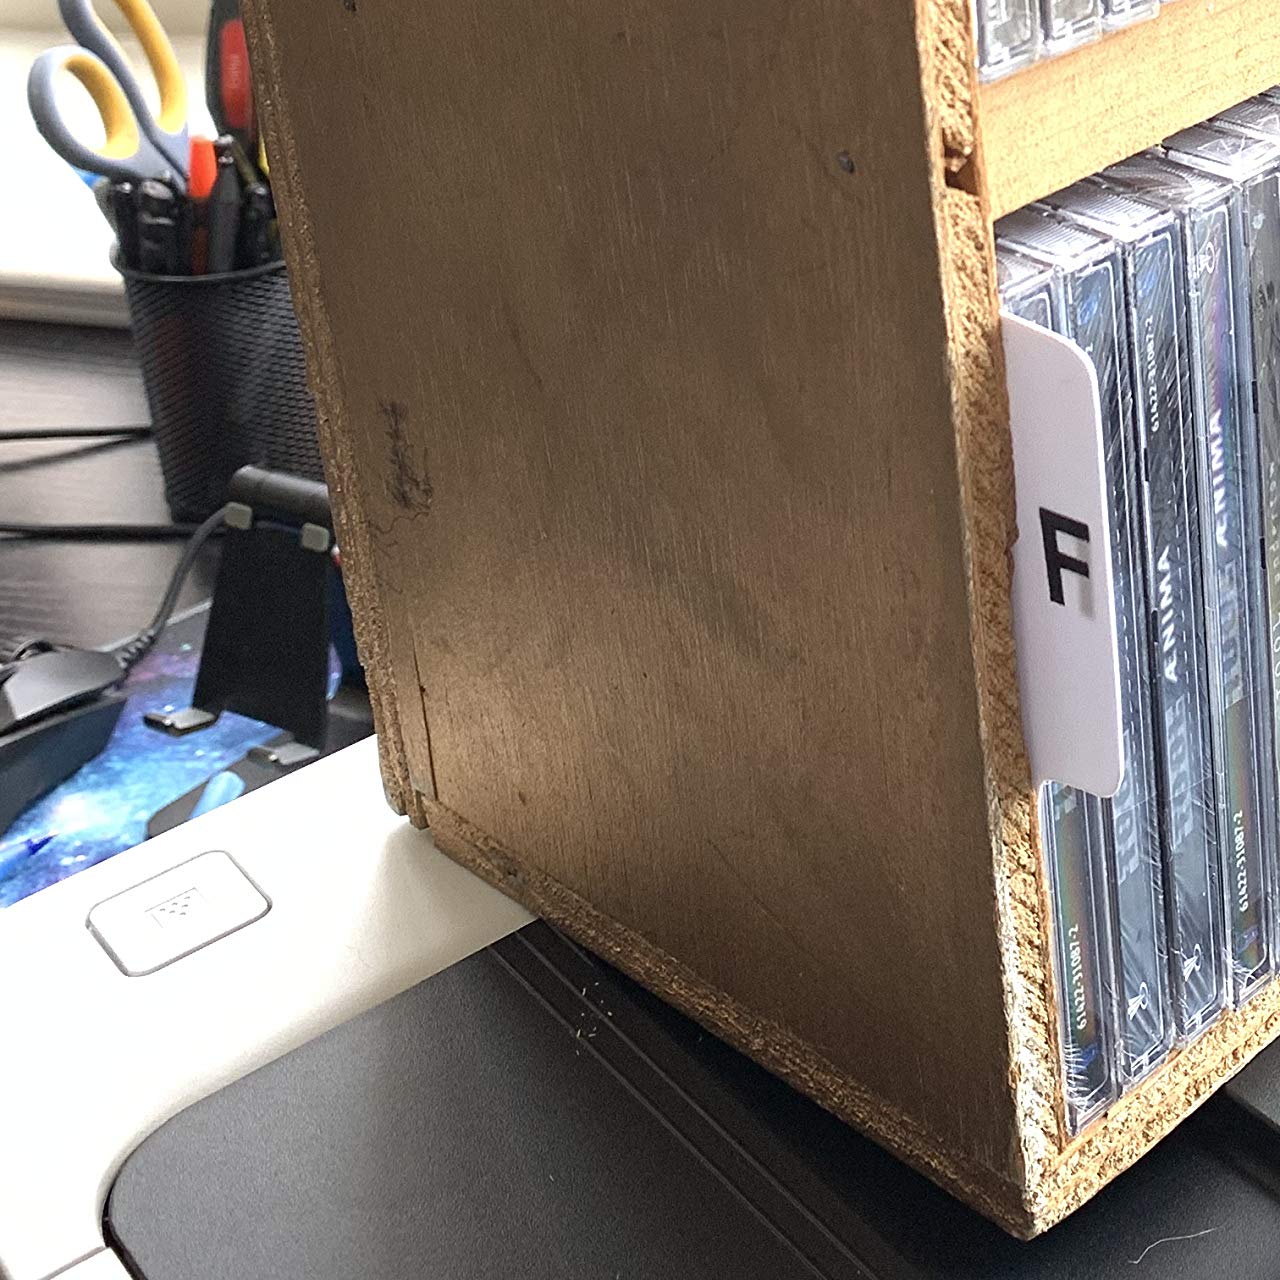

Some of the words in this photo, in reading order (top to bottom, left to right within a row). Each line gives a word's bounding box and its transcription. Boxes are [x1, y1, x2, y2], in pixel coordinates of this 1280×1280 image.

[1145, 316, 1159, 433] 61422-31087-2
[1208, 410, 1228, 549] ÆNIMA
[1039, 507, 1090, 606] F
[1156, 546, 1179, 685] ÆNIMA
[1232, 811, 1249, 913] 61422-31087-2
[1068, 924, 1088, 1032] 61422-31087-2
